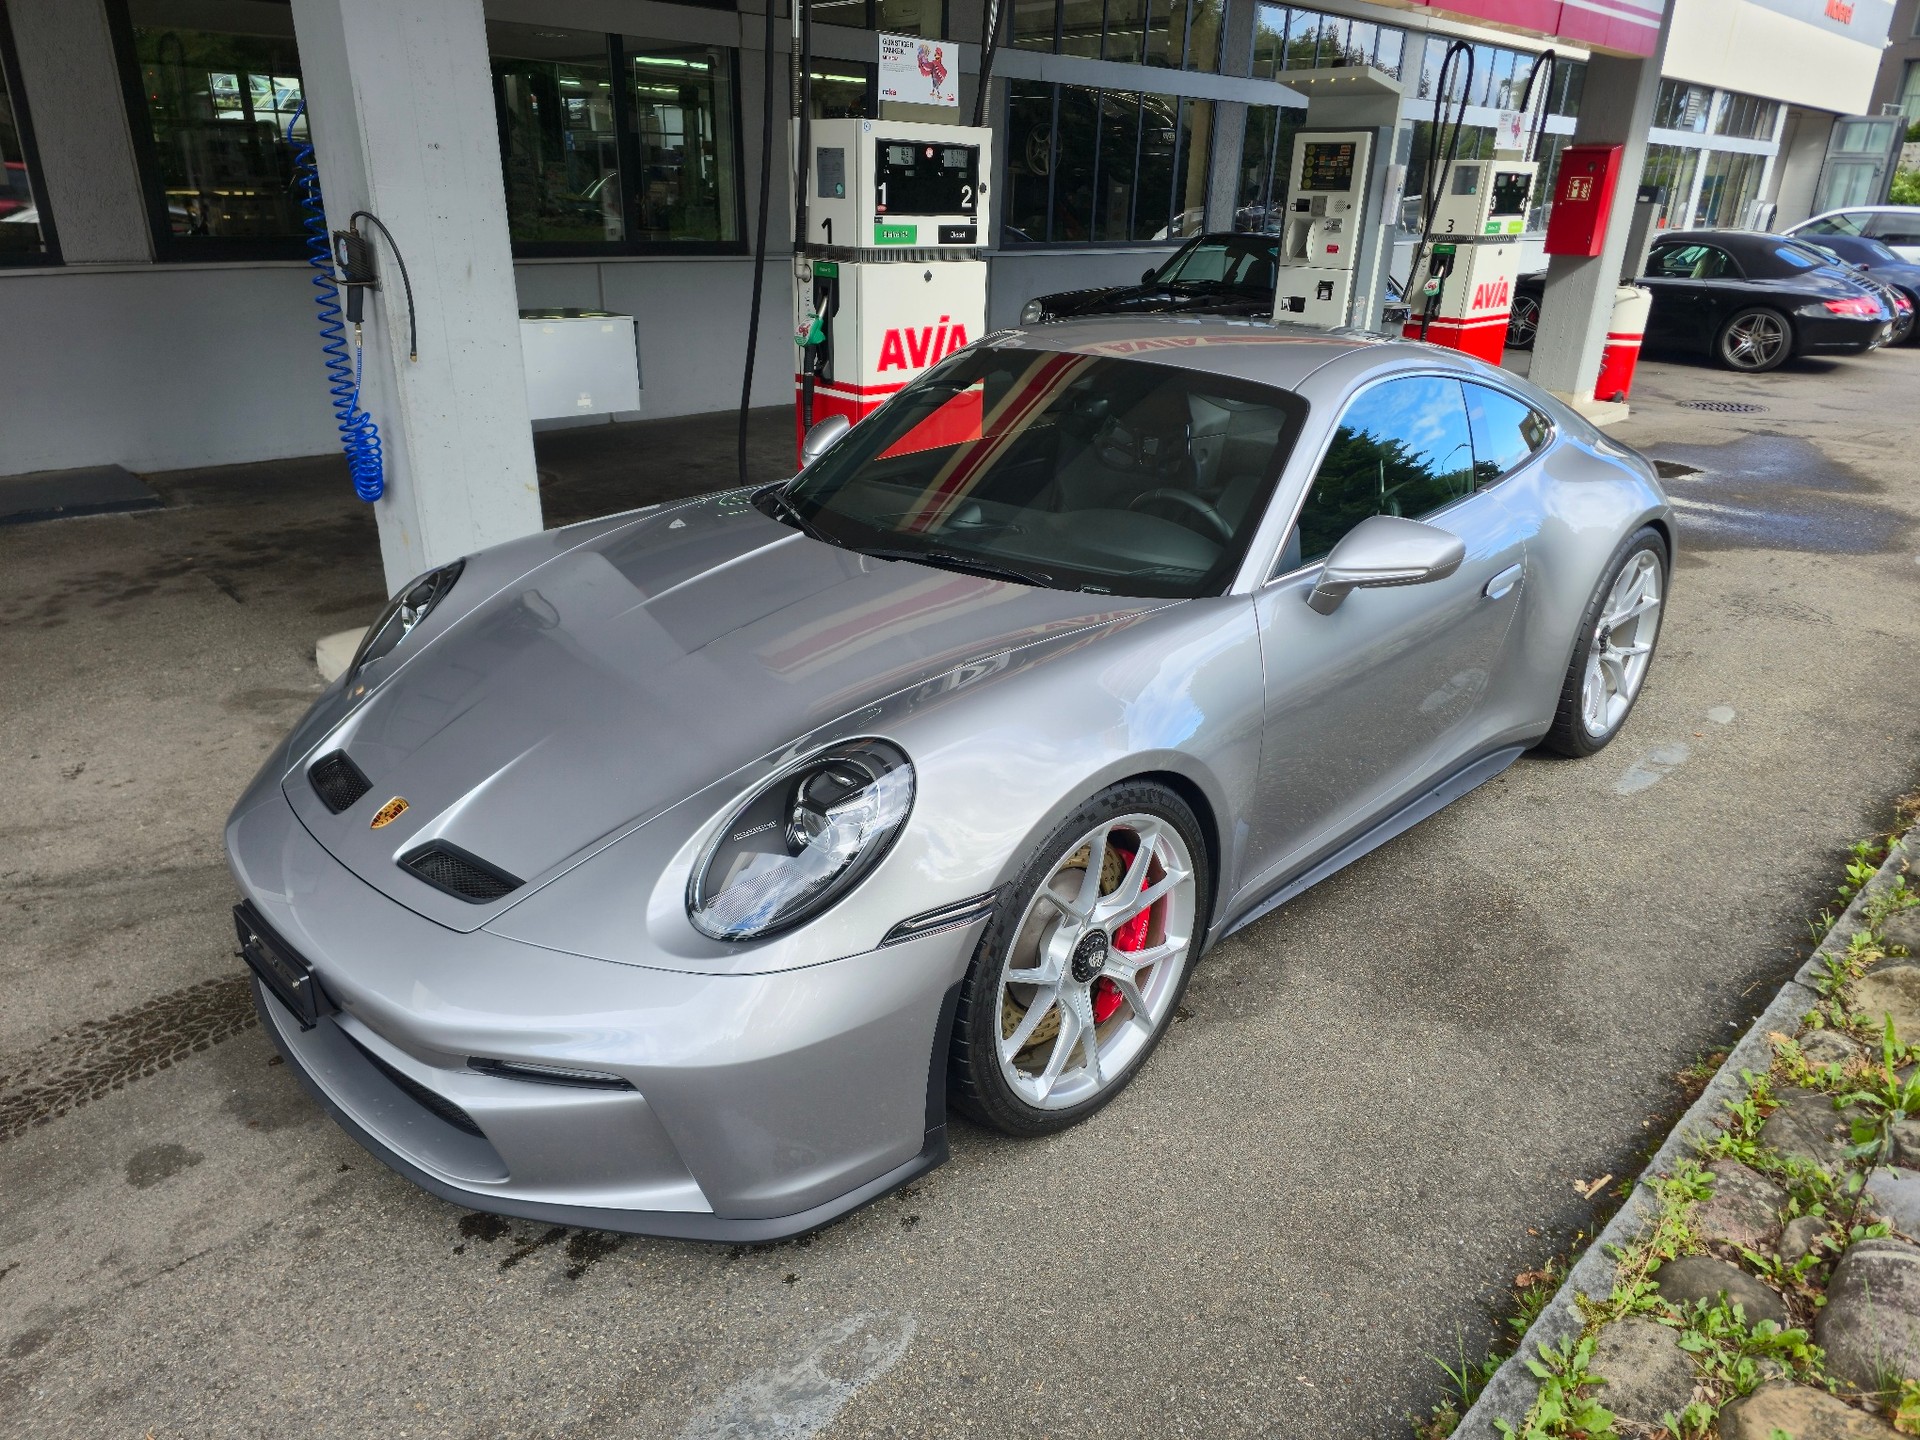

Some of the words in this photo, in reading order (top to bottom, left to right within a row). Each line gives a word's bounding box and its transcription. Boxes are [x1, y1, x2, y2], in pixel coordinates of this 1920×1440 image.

[882, 88, 897, 96] reka
[878, 182, 888, 205] 1
[961, 184, 972, 208] 2
[1490, 196, 1497, 210] 3
[1519, 196, 1526, 210] 4
[821, 217, 833, 244] 1
[1446, 219, 1455, 233] 3
[1471, 275, 1509, 310] AVIA
[877, 315, 968, 372] AVIA
